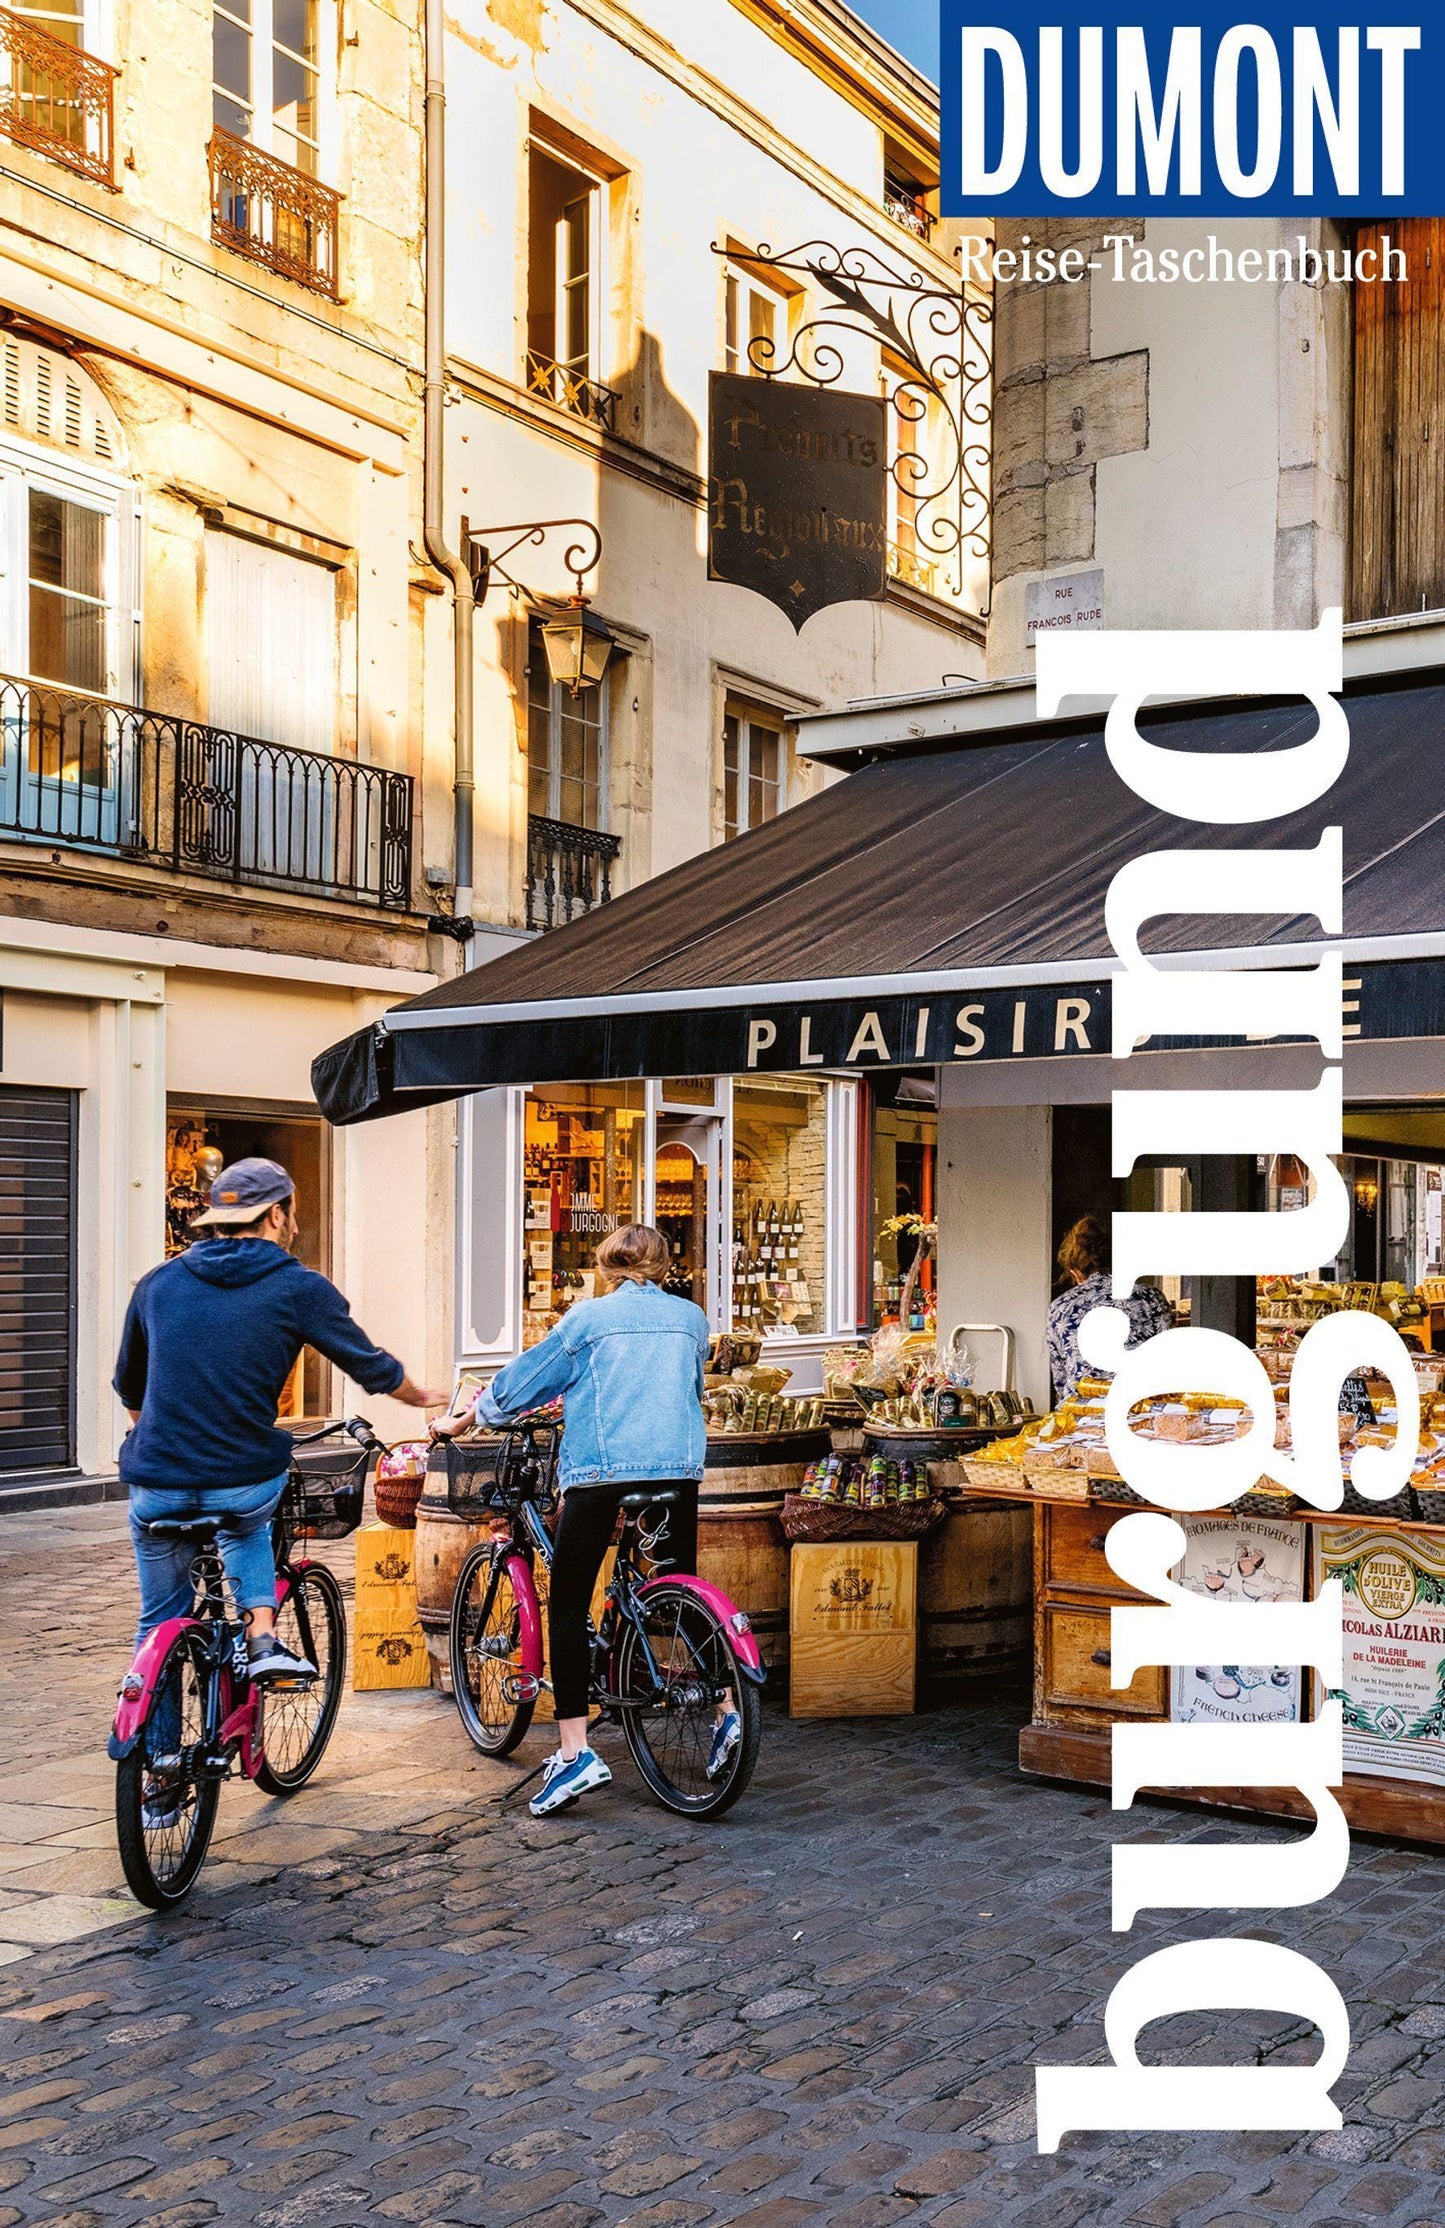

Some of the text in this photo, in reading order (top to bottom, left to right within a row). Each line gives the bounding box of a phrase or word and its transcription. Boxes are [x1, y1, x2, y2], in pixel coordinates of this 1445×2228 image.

[1055, 588, 1073, 600] RUE
[1027, 608, 1102, 631] FRANCOIS RUDE
[747, 997, 1151, 1067] PLAISIR
[564, 1213, 621, 1233] OURGOGNE
[1186, 1520, 1300, 1549] FROMAGES DE FRANCE
[1368, 1561, 1407, 1578] HUILE
[1370, 1588, 1405, 1602] VIERGE
[814, 1601, 893, 1613] Edmond Fallot
[1371, 1599, 1403, 1611] EXTRA
[1342, 1619, 1383, 1637] ICOLAS
[1369, 1645, 1408, 1658] HUILERIE
[1353, 1652, 1427, 1669] DE LA MADELEINE
